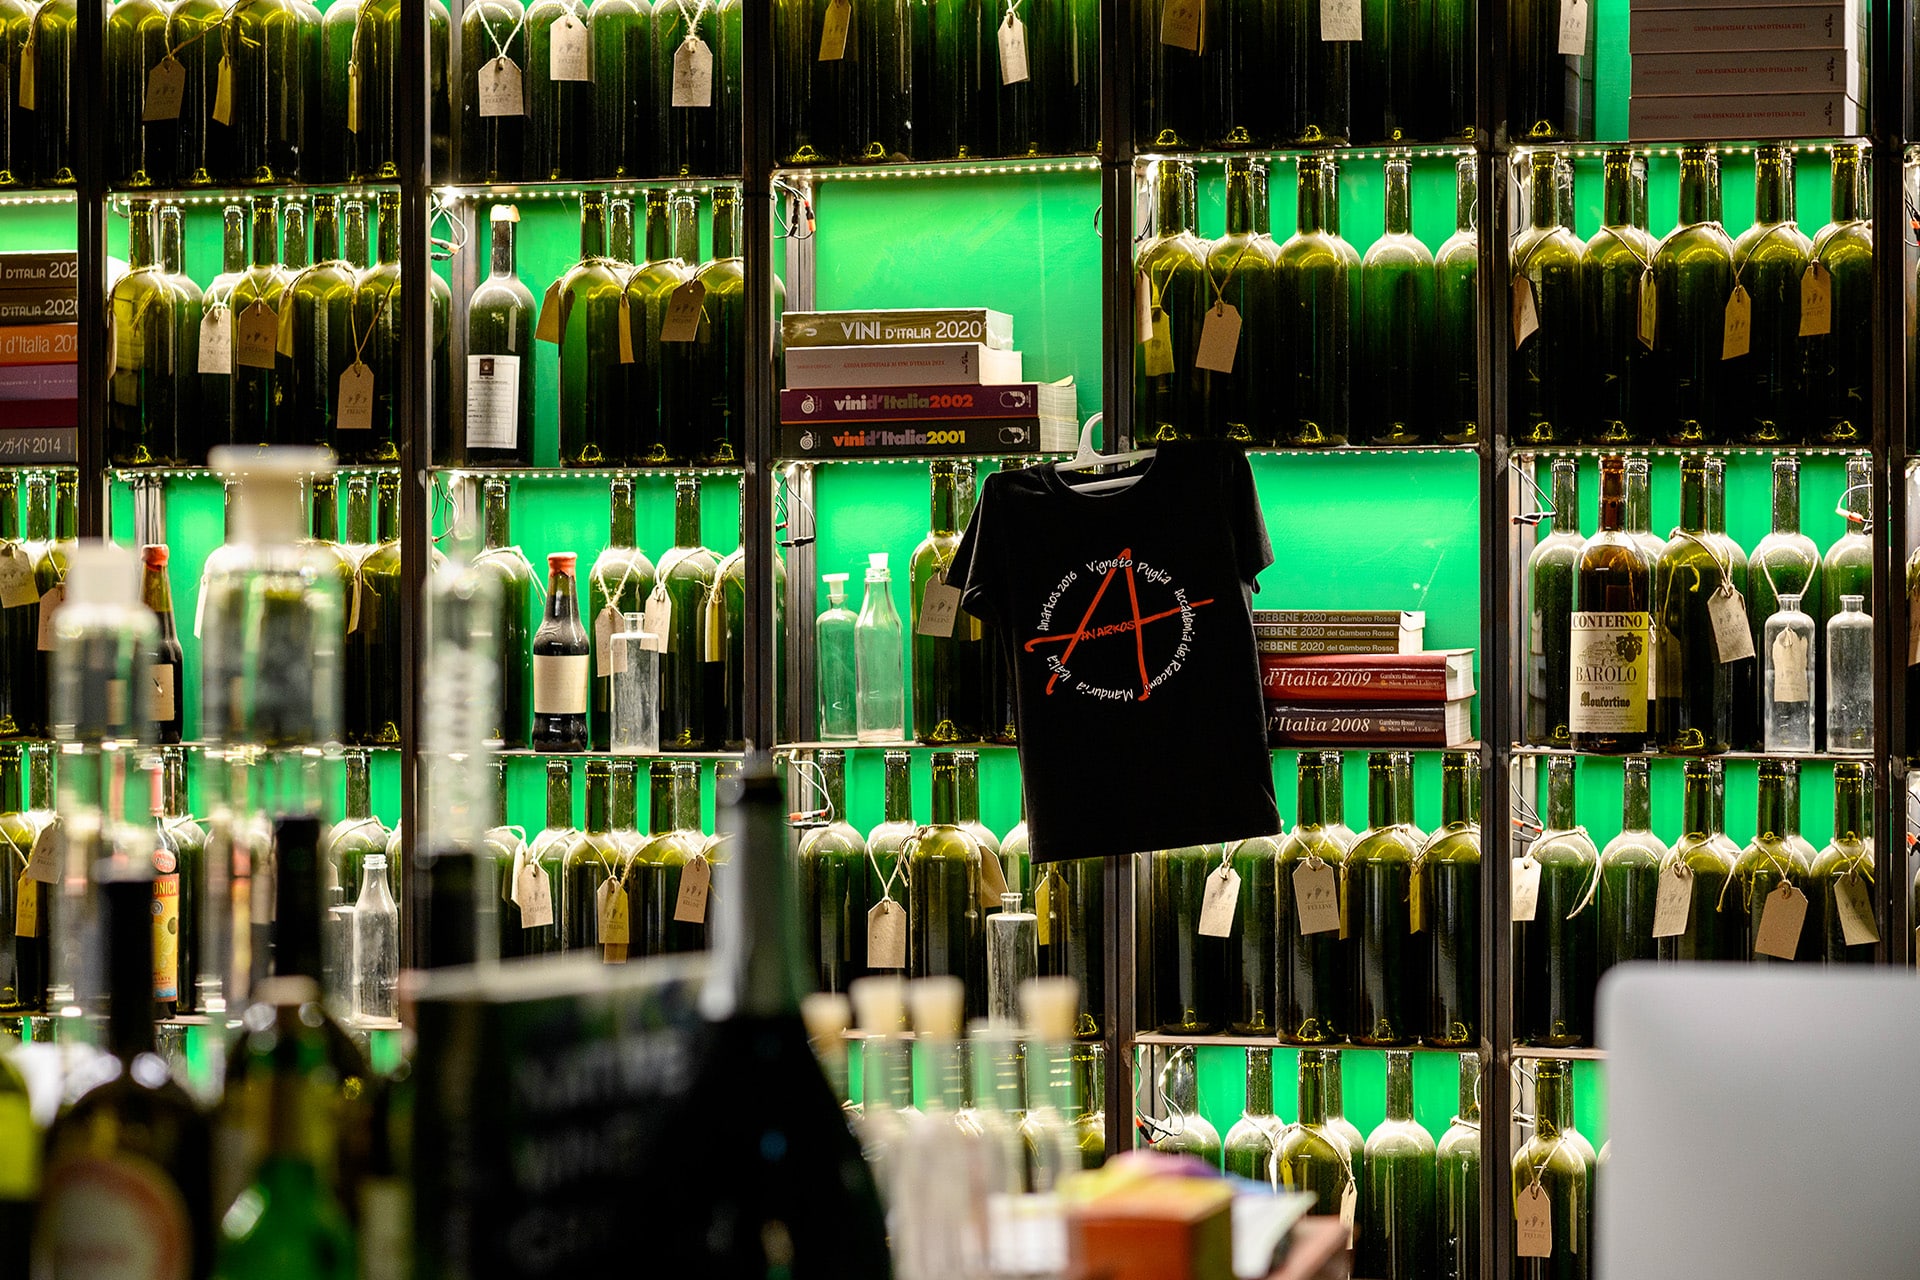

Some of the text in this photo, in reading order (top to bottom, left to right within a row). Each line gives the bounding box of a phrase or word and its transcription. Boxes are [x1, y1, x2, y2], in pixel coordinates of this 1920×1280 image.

[6, 262, 78, 279] D'ITALIA 202
[1, 305, 40, 316] D'ITALIA
[841, 321, 982, 340] VINI D'ITALIA 2020
[6, 334, 78, 353] d'Italia 201
[33, 437, 61, 453] 2014
[1302, 612, 1327, 622] 2020
[1573, 614, 1643, 628] CONTERNO
[1037, 557, 1197, 702] Anarkos 2016 Vigneto Puglia Accademia dei Racemi Manduria Italia
[1080, 622, 1137, 641] ANARKOS
[1300, 627, 1325, 636] 2020
[1326, 629, 1338, 637] del
[1300, 642, 1325, 651] 2020
[1264, 671, 1371, 688] d'Italia 2009
[1576, 665, 1637, 682] BAROLO
[1580, 690, 1630, 708] Monfortino
[1331, 717, 1370, 733] 2008
[1307, 903, 1334, 911] FELLINE
